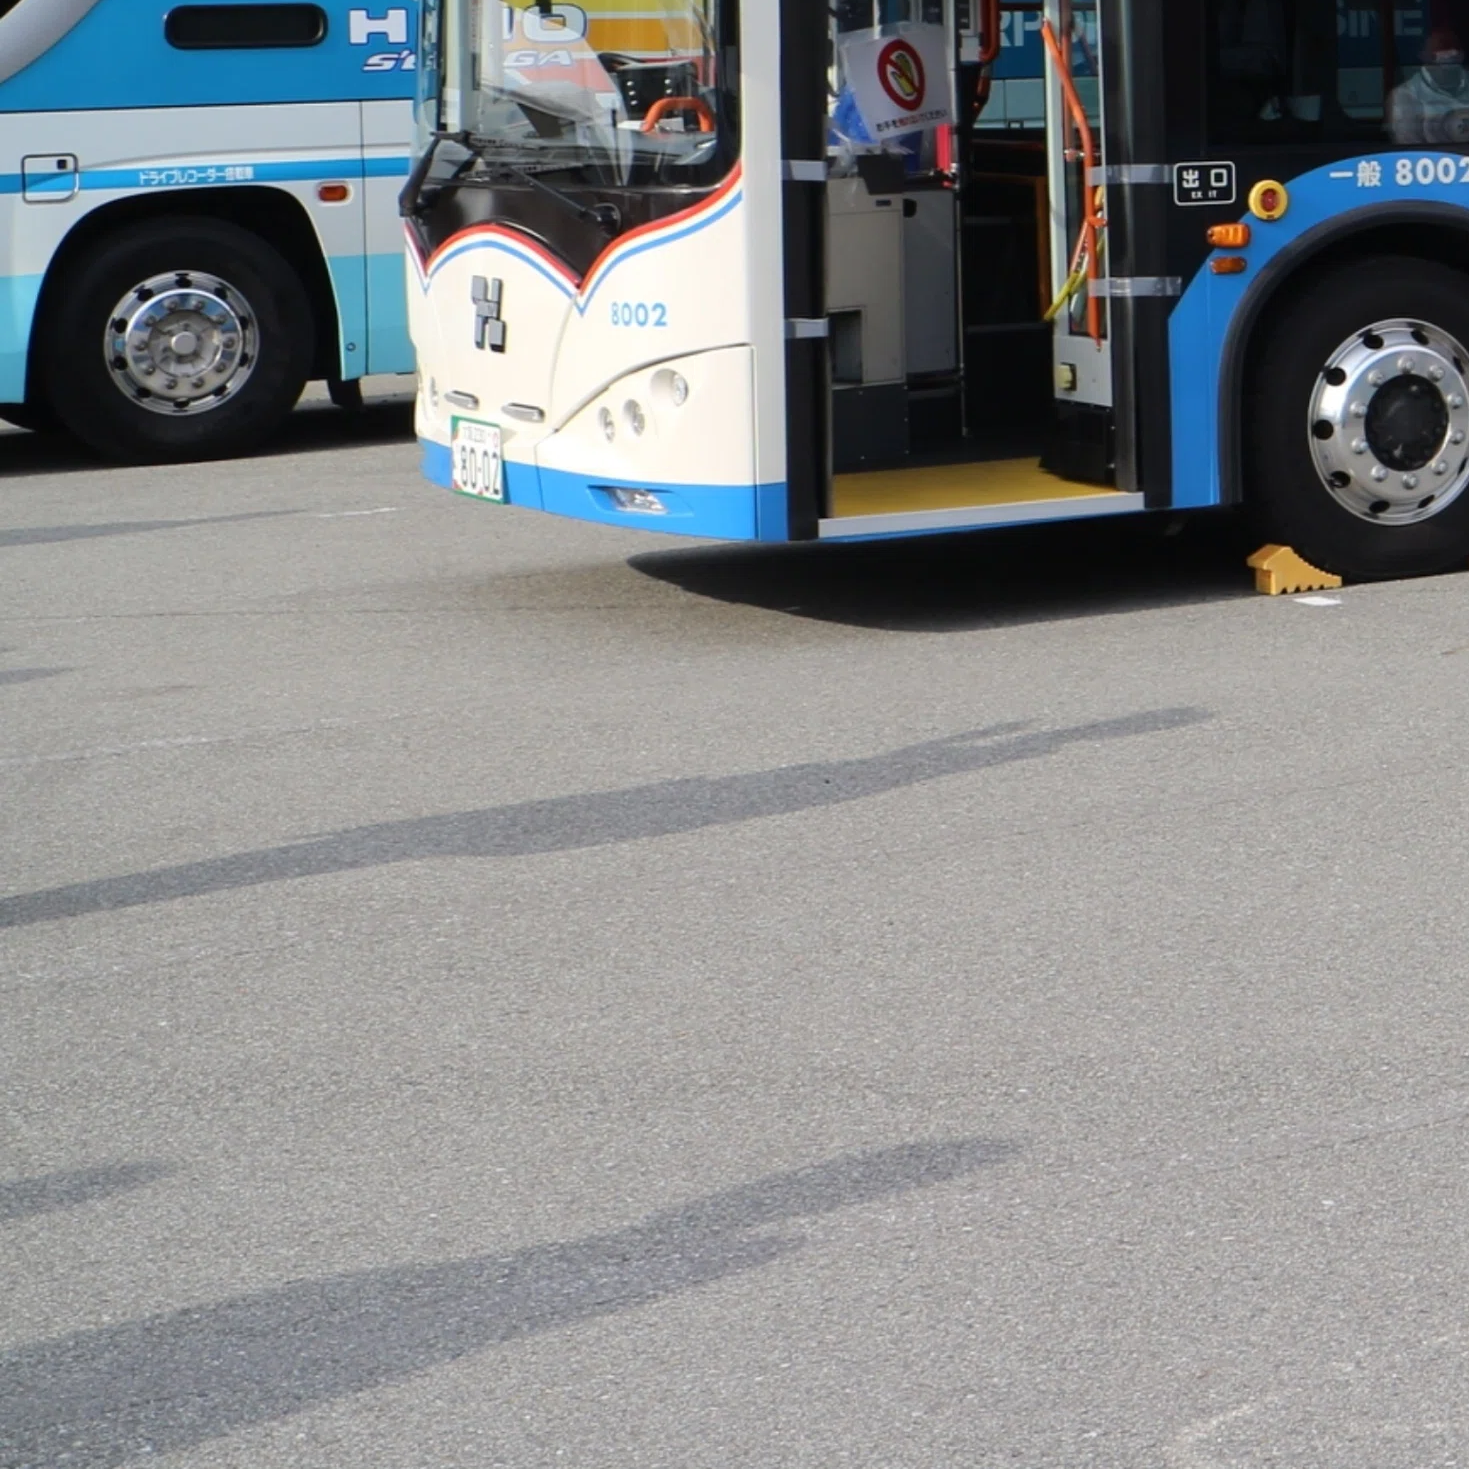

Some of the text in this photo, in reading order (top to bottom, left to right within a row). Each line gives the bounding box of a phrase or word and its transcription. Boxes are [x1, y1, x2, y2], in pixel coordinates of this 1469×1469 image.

[1182, 168, 1228, 188] 出口
[1329, 160, 1382, 187] 一般
[611, 301, 668, 328] 8002
[460, 445, 500, 495] 80-02
